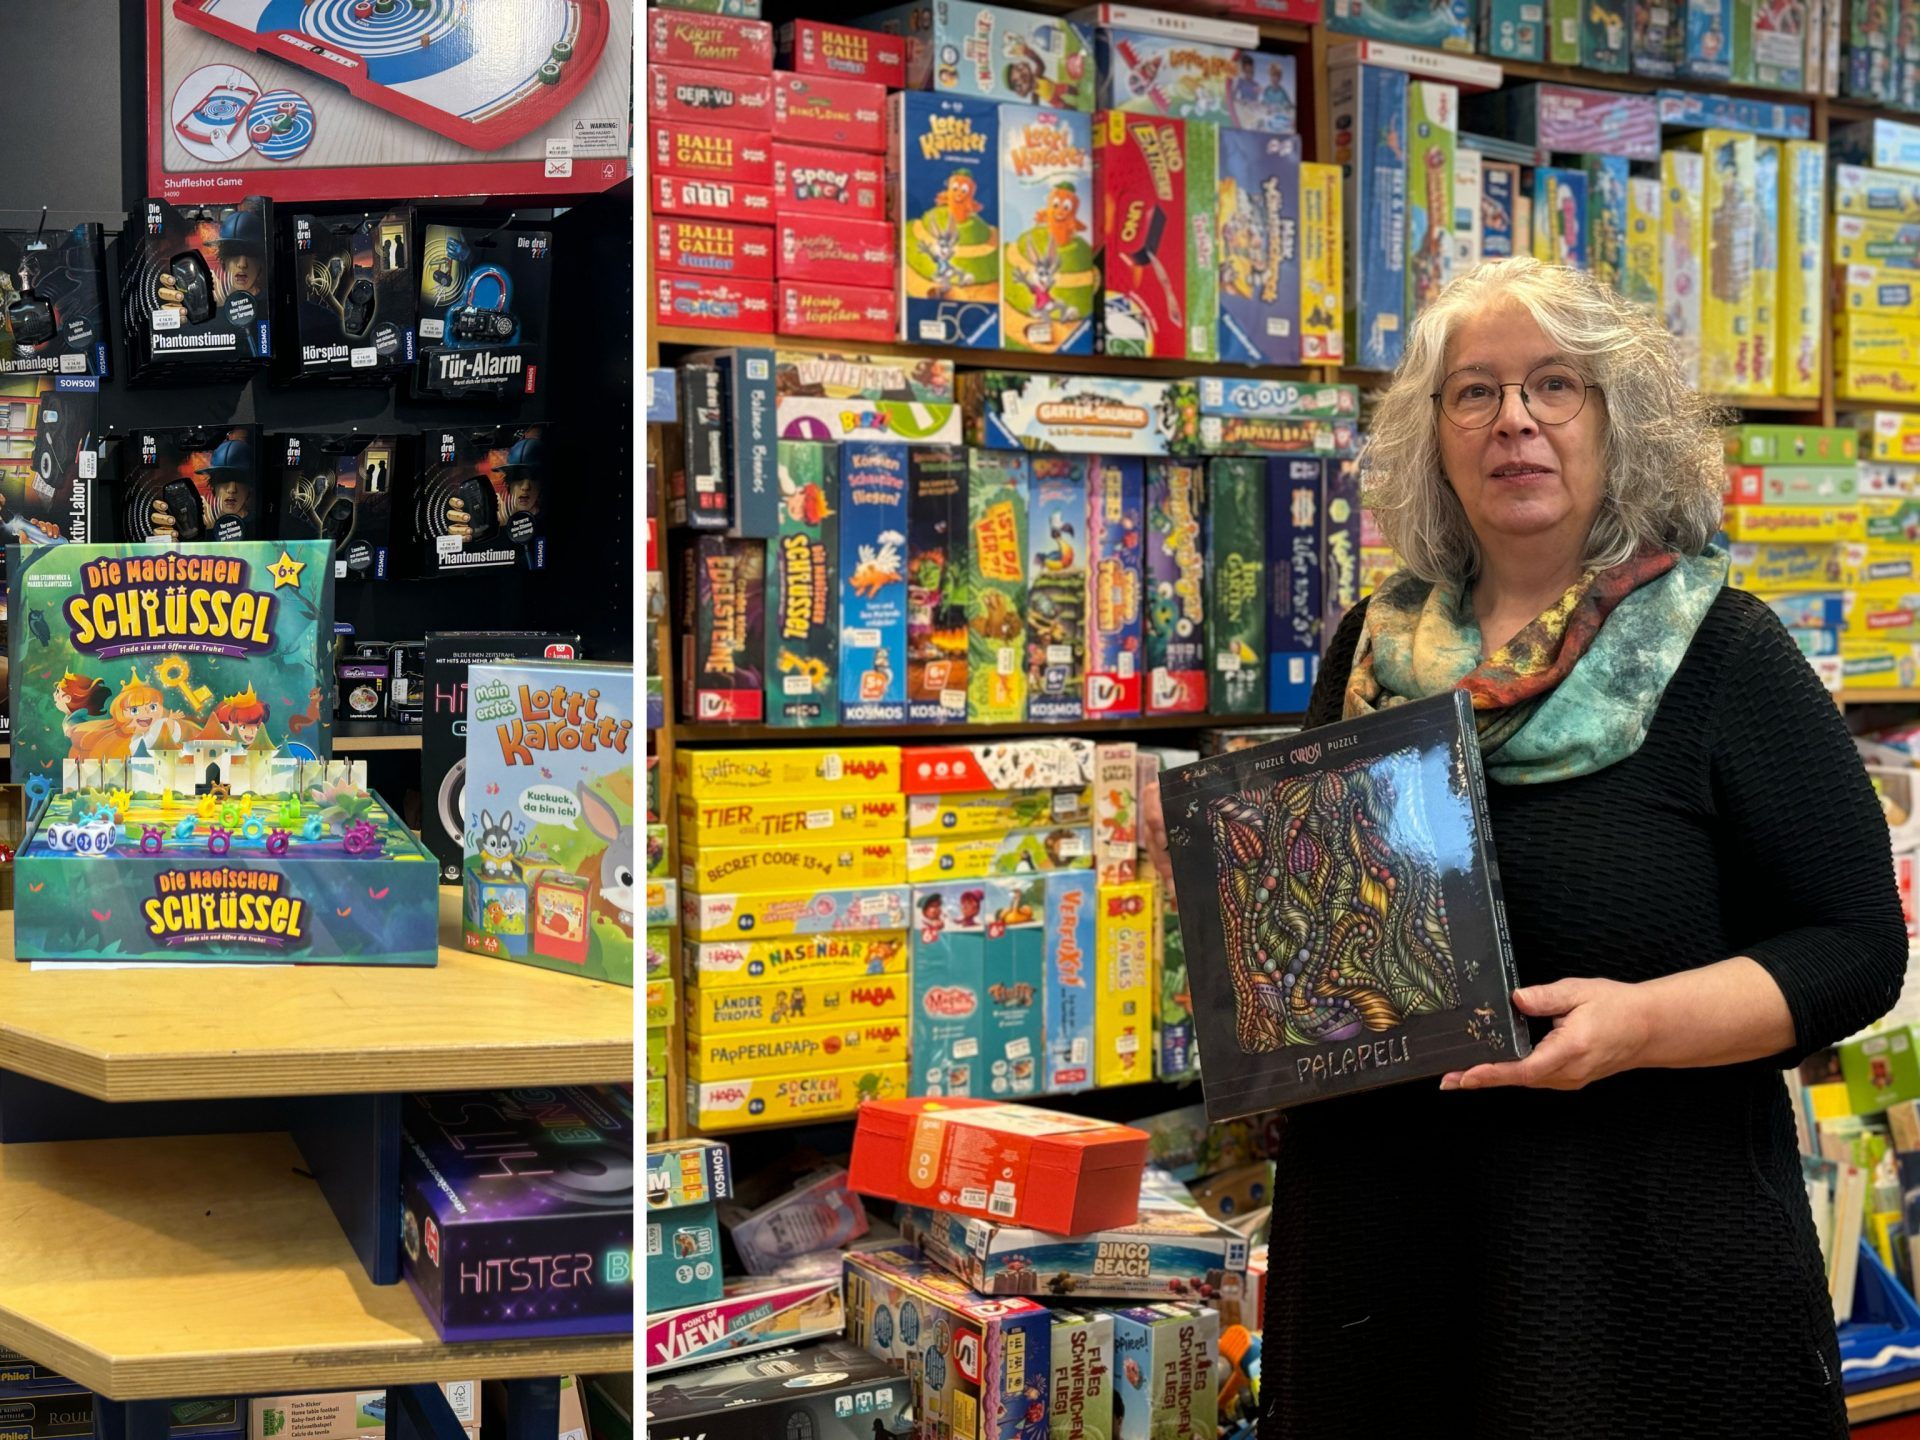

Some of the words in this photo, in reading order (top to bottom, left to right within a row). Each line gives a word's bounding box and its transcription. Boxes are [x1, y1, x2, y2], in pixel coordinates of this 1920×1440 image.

[821, 30, 868, 49] HALLI
[821, 45, 868, 62] GALLI
[929, 113, 971, 134] Lotti
[677, 134, 733, 151] HALLI
[1023, 124, 1069, 149] Lotti
[919, 132, 987, 159] Karotti
[1160, 126, 1183, 173] UNO
[677, 149, 733, 166] GALLI
[1010, 143, 1085, 176] Karotti
[164, 177, 214, 189] Shuffleshot
[216, 177, 243, 187] Game
[791, 168, 848, 189] Speed
[148, 204, 160, 214] Die
[147, 213, 162, 224] drei
[297, 220, 309, 230] Die
[1121, 201, 1144, 242] UNO
[297, 229, 311, 240] drei
[677, 223, 734, 242] HALLI
[518, 237, 530, 248] Die
[531, 237, 547, 248] drei
[677, 239, 734, 256] GALLI
[678, 253, 734, 270] Junior
[152, 332, 236, 349] Phantomstimme
[302, 343, 349, 360] Hörspion
[439, 352, 522, 379] Tür-Alarm
[799, 360, 861, 387] PUZZLE
[60, 379, 96, 388] KOSMOS
[1235, 386, 1299, 409] CLOUD
[751, 390, 768, 440] Balance
[143, 435, 155, 445] Die
[289, 438, 300, 448] Die
[441, 443, 455, 452] drei
[442, 434, 454, 444] Die
[142, 445, 157, 455] drei
[287, 447, 301, 457] drei
[69, 479, 85, 543] ktiv-Labor
[377, 550, 385, 577] KOSMOS
[438, 549, 515, 565] Phantomstimme
[278, 565, 296, 578] 6+
[119, 646, 139, 654] Finde
[140, 644, 151, 652] sie
[152, 643, 166, 651] und
[167, 642, 187, 652] öffne
[188, 642, 200, 651] die
[201, 644, 224, 653] Truhe!
[475, 679, 510, 703] Mein
[475, 699, 517, 722] erstes
[518, 684, 600, 726] Lotti
[846, 705, 903, 721] KOSMOS
[1029, 703, 1081, 716] KOSMOS
[496, 715, 633, 766] Karotti
[1255, 756, 1285, 771] PUZZLE
[1290, 742, 1322, 765] CURIOSI
[1327, 735, 1359, 752] PUZZLE
[843, 760, 888, 780] HABA
[523, 803, 537, 812] da
[539, 804, 556, 814] bin
[557, 806, 577, 817] ich!
[862, 802, 898, 818] HABA
[702, 805, 753, 829] TIER
[761, 811, 808, 836] TIER
[862, 846, 892, 858] HABA
[706, 854, 759, 883] SECRET
[762, 852, 801, 866] CODE
[803, 856, 833, 876] 13+4
[708, 904, 732, 914] HABA
[739, 917, 753, 927] 4+
[708, 951, 744, 964] HABA
[1117, 928, 1132, 990] GAMES
[748, 963, 763, 974] 4+
[714, 995, 762, 1011] LÄNDER
[850, 987, 896, 1007] HABA
[714, 1010, 763, 1023] EUROPAS
[865, 1027, 900, 1042] HABA
[1297, 1036, 1411, 1083] PALAPELI
[709, 1088, 745, 1103] HABA
[776, 1078, 838, 1098] SOCKEN
[749, 1102, 764, 1112] 4+
[789, 1091, 842, 1107] ZOCKEN
[712, 1148, 726, 1198] KOSMOS
[1097, 1241, 1150, 1258] BINGO
[460, 1253, 593, 1294] HITSTER
[1093, 1258, 1151, 1278] BEACH
[682, 1313, 706, 1330] POINT
[706, 1309, 718, 1319] OF
[655, 1320, 725, 1363] VIEW
[1, 1372, 31, 1381] Philos
[1068, 1330, 1087, 1440] SCHWEINCHEN
[1177, 1325, 1195, 1435] SCHWEINCHEN
[1052, 1367, 1068, 1416] FLIEG!
[1161, 1361, 1177, 1411] FLIEG!
[291, 1401, 321, 1409] Tisch-Kicker
[0, 1432, 29, 1440] Philos
